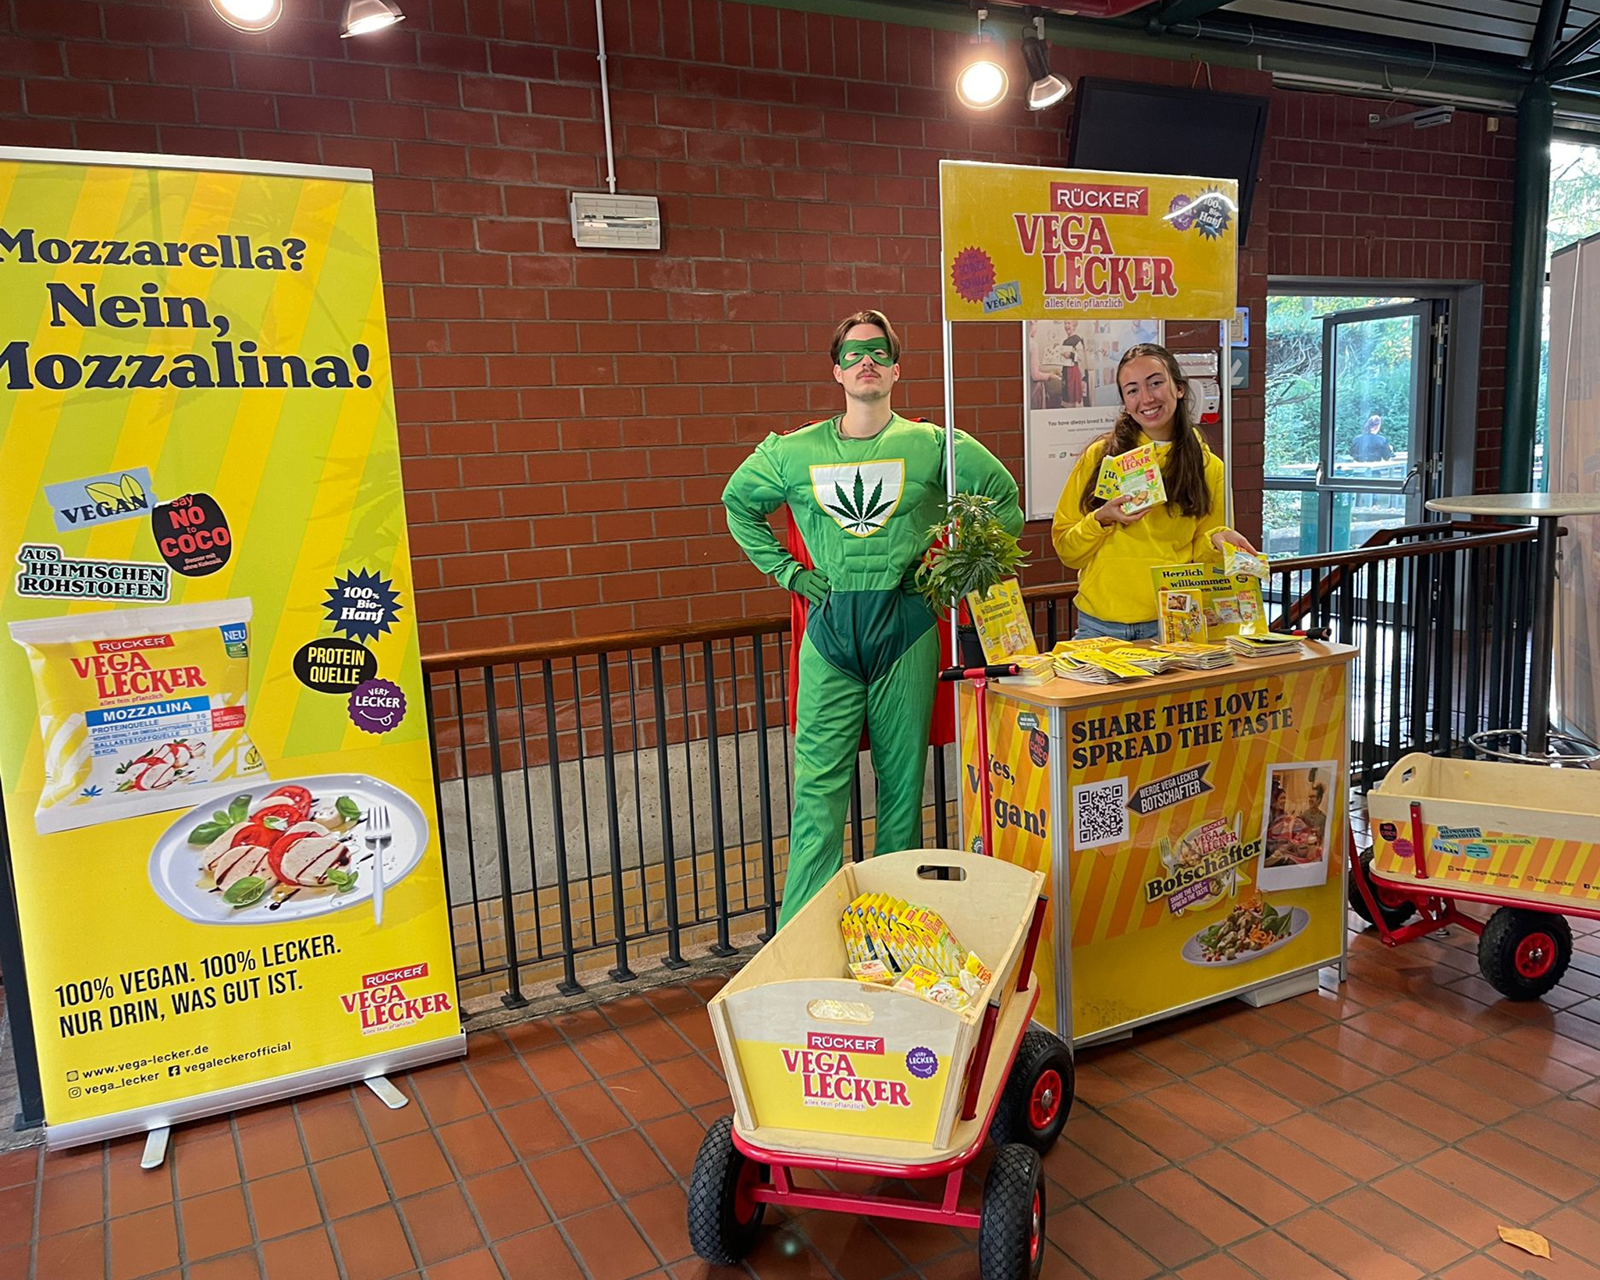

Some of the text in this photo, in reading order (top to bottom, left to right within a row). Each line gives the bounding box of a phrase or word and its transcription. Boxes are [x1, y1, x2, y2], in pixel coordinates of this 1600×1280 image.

[1056, 188, 1142, 209] RÜCKER
[1199, 211, 1223, 228] Hanf
[1013, 214, 1114, 255] VEGA
[0, 228, 306, 271] Mozzarella?
[1042, 251, 1178, 302] LECKER
[46, 283, 230, 338] Nein,
[986, 294, 1019, 310] VEGAN
[1044, 298, 1123, 310] alles fein pflanzlich
[1070, 419, 1086, 427] always
[1122, 455, 1151, 472] LECKER
[61, 494, 149, 523] VEGAN
[172, 495, 193, 507] say
[169, 506, 205, 529] NO
[160, 527, 231, 557] COCO
[24, 549, 57, 561] AUS
[30, 562, 167, 582] HEIMISCHEN
[1162, 569, 1203, 578] Herzlich
[23, 577, 164, 598] ROHSTOFFEN
[1170, 577, 1231, 588] willkommen
[343, 587, 379, 600] 100%
[357, 600, 382, 609] Bio-
[340, 607, 385, 625] Hanf
[223, 630, 246, 641] NEU
[70, 651, 152, 680] VEGA
[307, 646, 366, 667] PROTEIN
[96, 665, 207, 699] LECKER
[309, 666, 361, 685] QUELLE
[367, 687, 390, 697] VERY
[103, 701, 192, 722] MOZZALINA
[355, 696, 401, 709] LECKER
[1071, 709, 1157, 744] SHARE
[1161, 699, 1209, 728] THE
[1214, 687, 1270, 718] LOVE
[91, 719, 159, 735] PROTEINQUELLE
[94, 731, 180, 749] BALLASTSTOFFQUELLE
[1034, 732, 1046, 747] NO
[1072, 706, 1294, 770] SPREAD THE TASTE
[1030, 741, 1048, 761] COCO
[1139, 769, 1199, 798] WERDE VEGA LECKER
[1141, 780, 1201, 813] BOTSCHAFTER
[994, 798, 1047, 839] gan!
[1193, 830, 1219, 848] VEGA
[1200, 831, 1238, 855] LECKER
[1434, 844, 1459, 855] VEGAN
[1148, 839, 1262, 900] Botschafter
[1455, 866, 1519, 880] www.vega-lecker.de
[1535, 877, 1575, 887] vega_lecker
[55, 934, 342, 1008] 100% VEGAN. 100% LECKER.
[60, 970, 303, 1038] NUR DRIN, WAS GUT IST.
[340, 984, 406, 1013] VEGA
[360, 992, 452, 1029] LECKER
[811, 1036, 878, 1051] RÜCKER
[82, 1044, 210, 1081] www.vega-lecker.de
[84, 1041, 292, 1096] vega_lecker vegaleckerofficial
[782, 1049, 857, 1078] VEGA
[909, 1056, 935, 1065] LECKER
[802, 1072, 911, 1107] LECKER
[834, 1100, 866, 1111] pflanzlich
